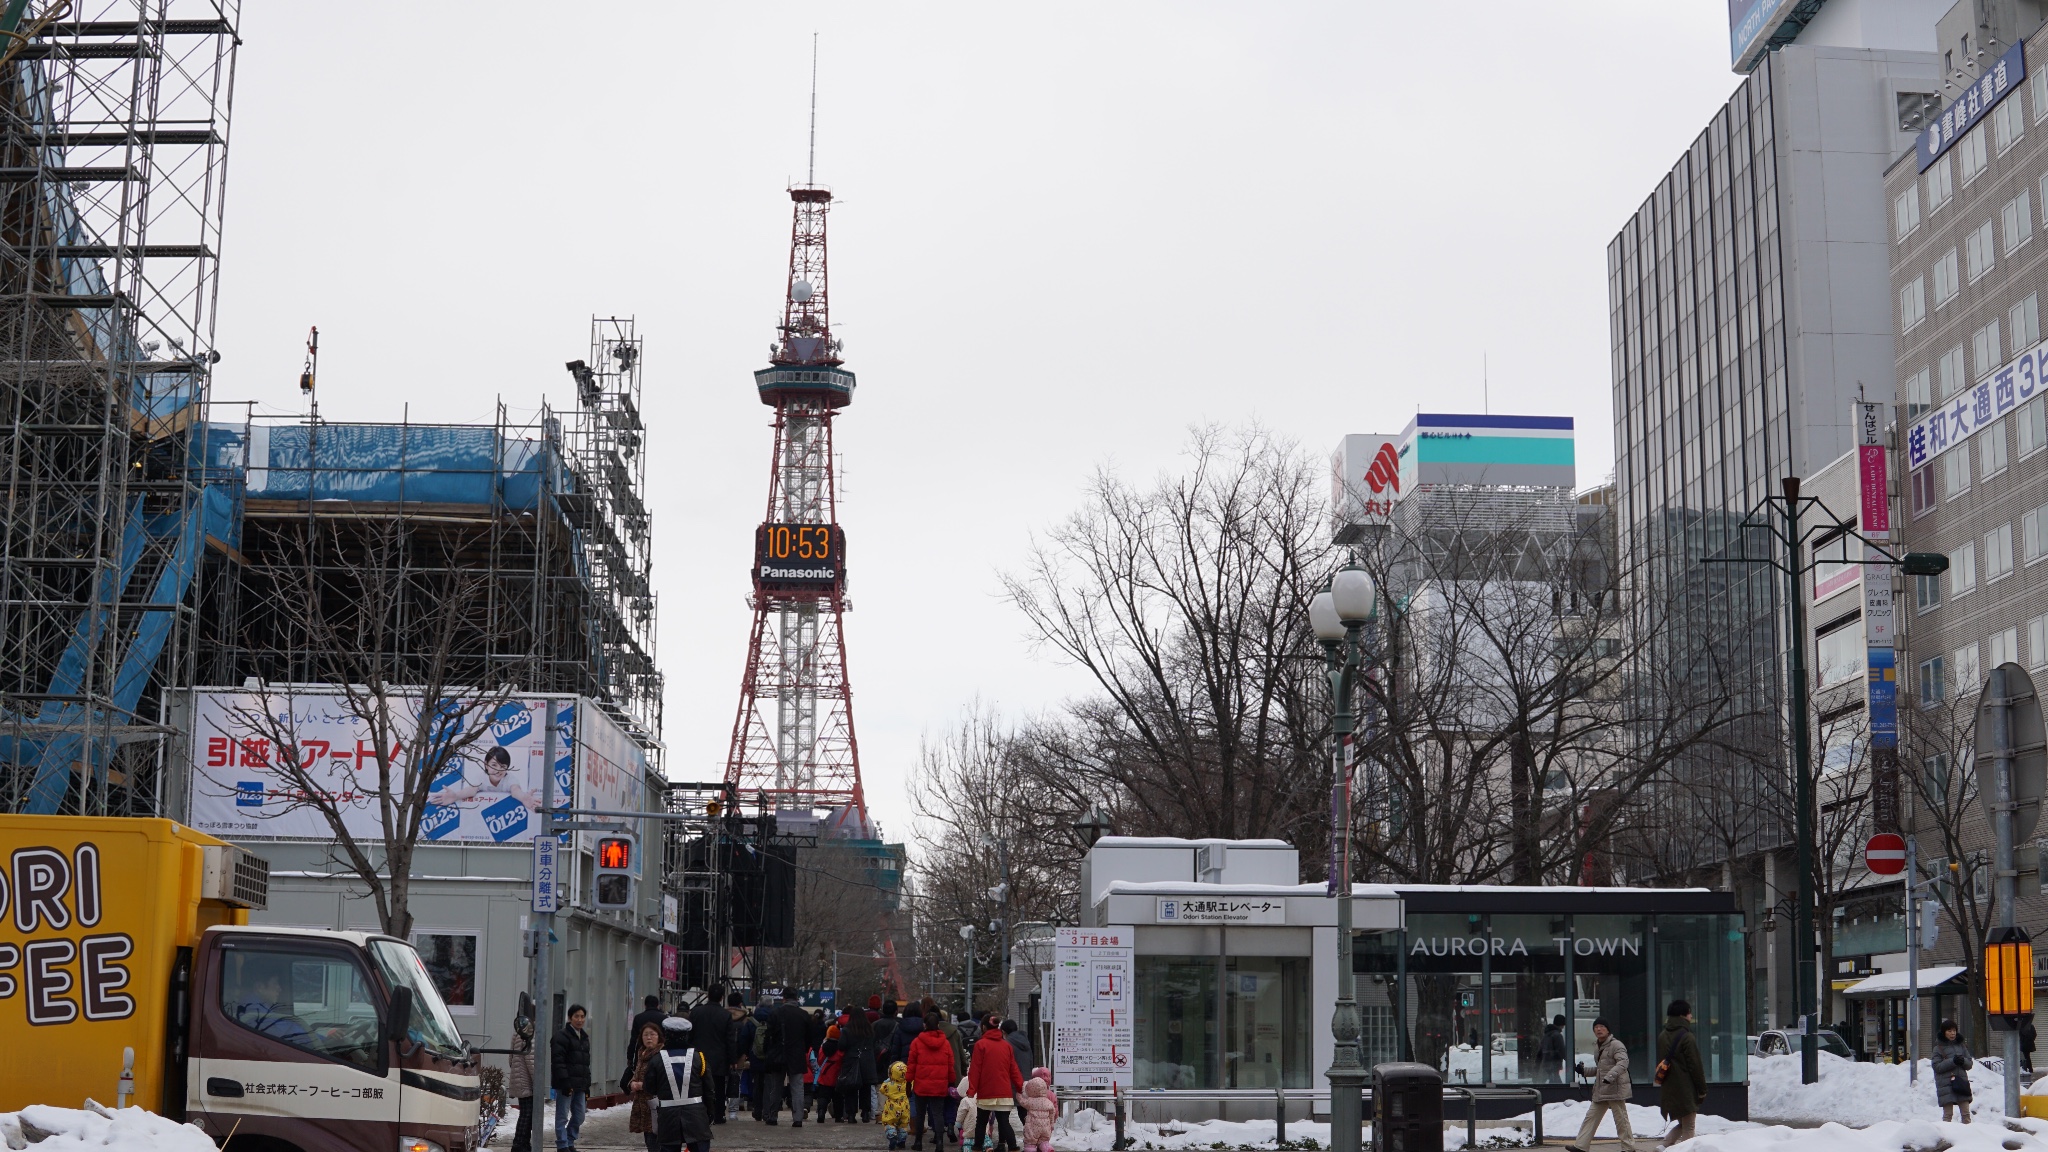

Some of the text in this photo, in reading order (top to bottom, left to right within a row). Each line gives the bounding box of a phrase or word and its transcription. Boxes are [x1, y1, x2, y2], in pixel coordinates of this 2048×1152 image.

[1738, 7, 1761, 49] NORTH
[767, 526, 829, 559] 10:53
[760, 565, 835, 579] Panasonic
[1867, 589, 1890, 597] グレイス
[1867, 609, 1891, 617] クリニック
[1875, 625, 1885, 633] 5F
[493, 705, 531, 738] 0123
[421, 803, 459, 832] 0123
[485, 814, 497, 823] the
[489, 805, 527, 834] 0123
[538, 840, 553, 909] 歩車分離式
[0, 841, 102, 934] RI
[1182, 901, 1282, 913] 大通駅エレベーター
[1071, 936, 1119, 946] 3丁目会場
[1410, 937, 1640, 957] AURORA TOWN
[244, 1082, 384, 1101] 社会式株ズーフーヒーコ部服
